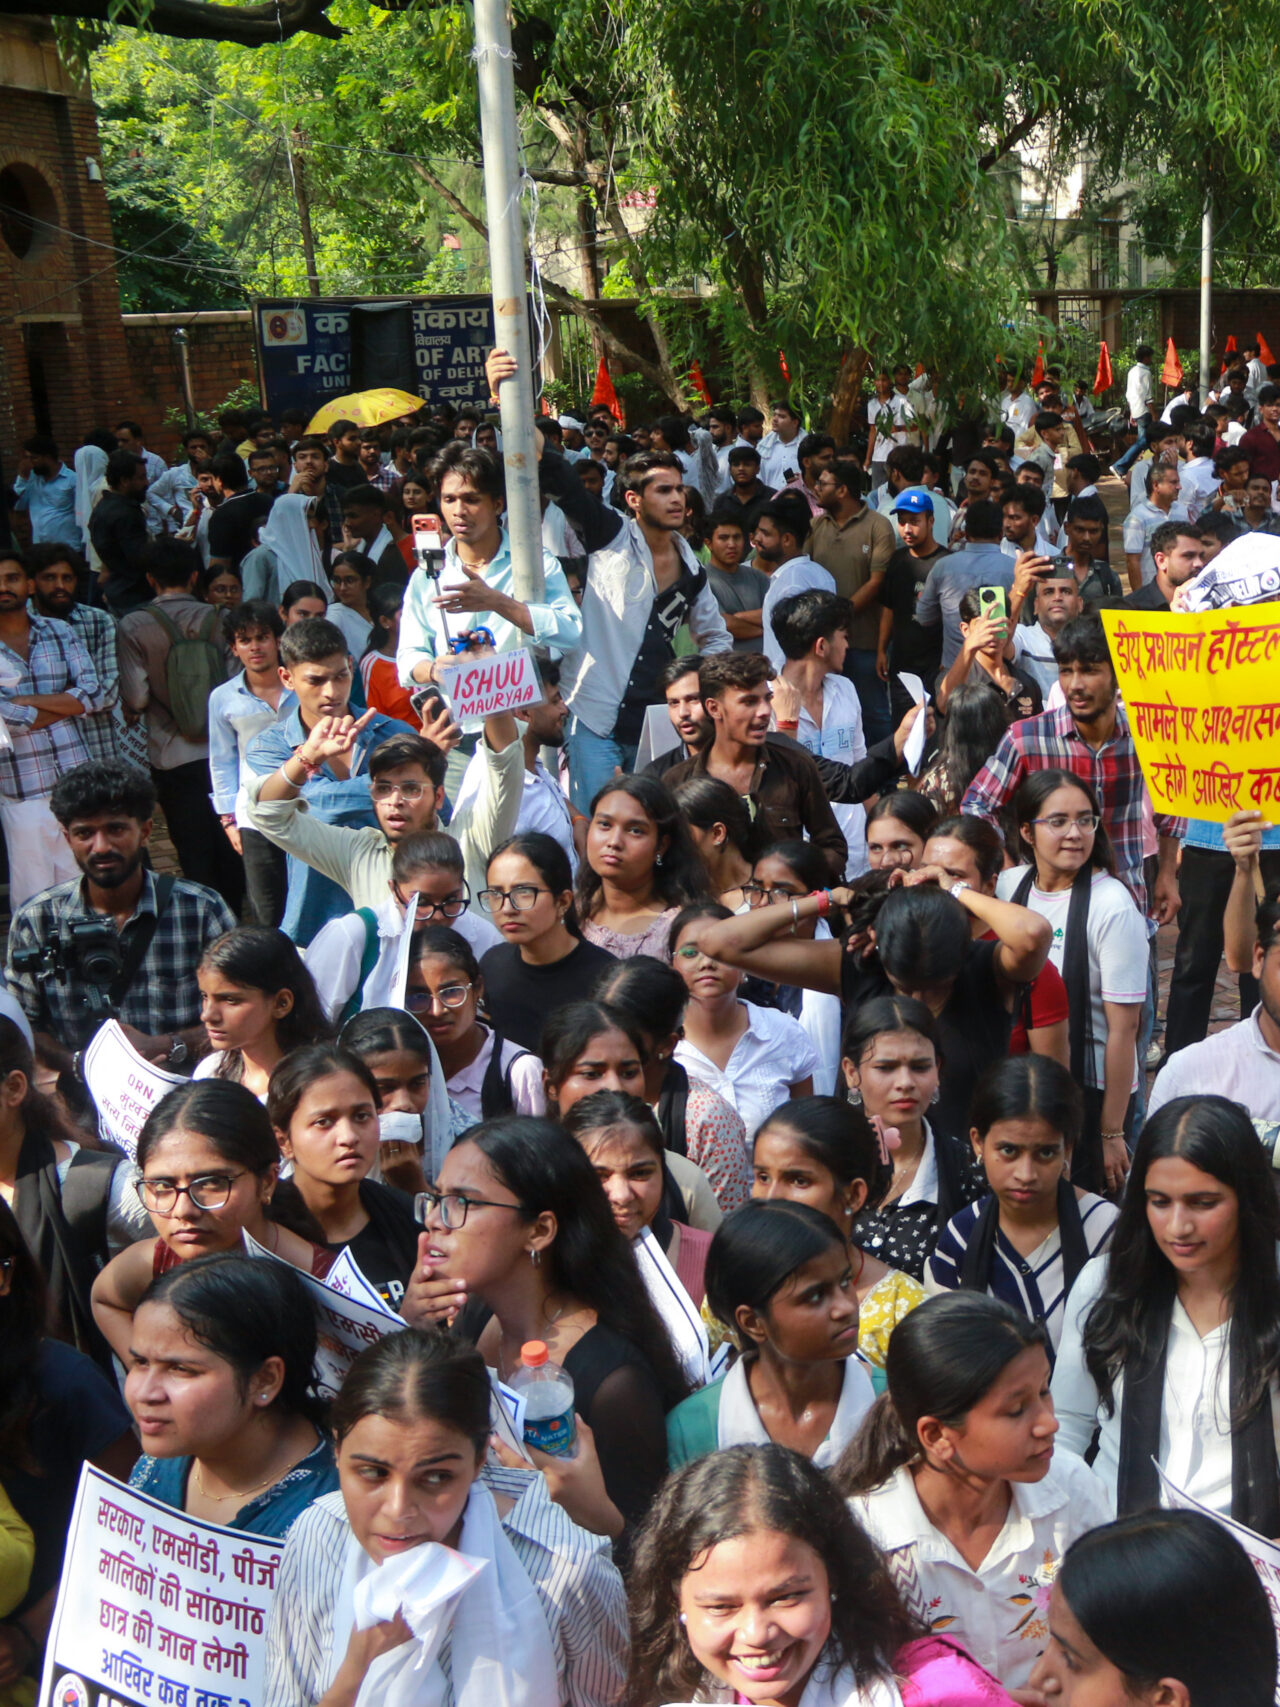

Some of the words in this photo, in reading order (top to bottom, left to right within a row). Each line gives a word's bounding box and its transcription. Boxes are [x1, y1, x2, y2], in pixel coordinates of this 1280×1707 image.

[416, 348, 443, 367] OF
[451, 346, 494, 364] ART
[423, 369, 441, 381] OF
[447, 367, 485, 379] DELH
[453, 658, 524, 700] ISHUU
[459, 684, 533, 718] MAURYAA
[1130, 690, 1179, 744] मामले
[1180, 706, 1200, 744] पर
[1193, 760, 1244, 810] आखिर
[97, 1496, 146, 1552] सरकार,
[152, 1524, 225, 1583] एमसीडी,
[99, 1548, 158, 1601] मालिकों
[159, 1572, 181, 1612] की
[185, 1587, 266, 1635] सांठगांठ
[99, 1598, 128, 1637] छात्र
[133, 1609, 153, 1649] की
[157, 1625, 197, 1666] जान
[202, 1636, 249, 1680] लेगी
[101, 1648, 153, 1698] आखिर
[158, 1674, 190, 1707] कब
